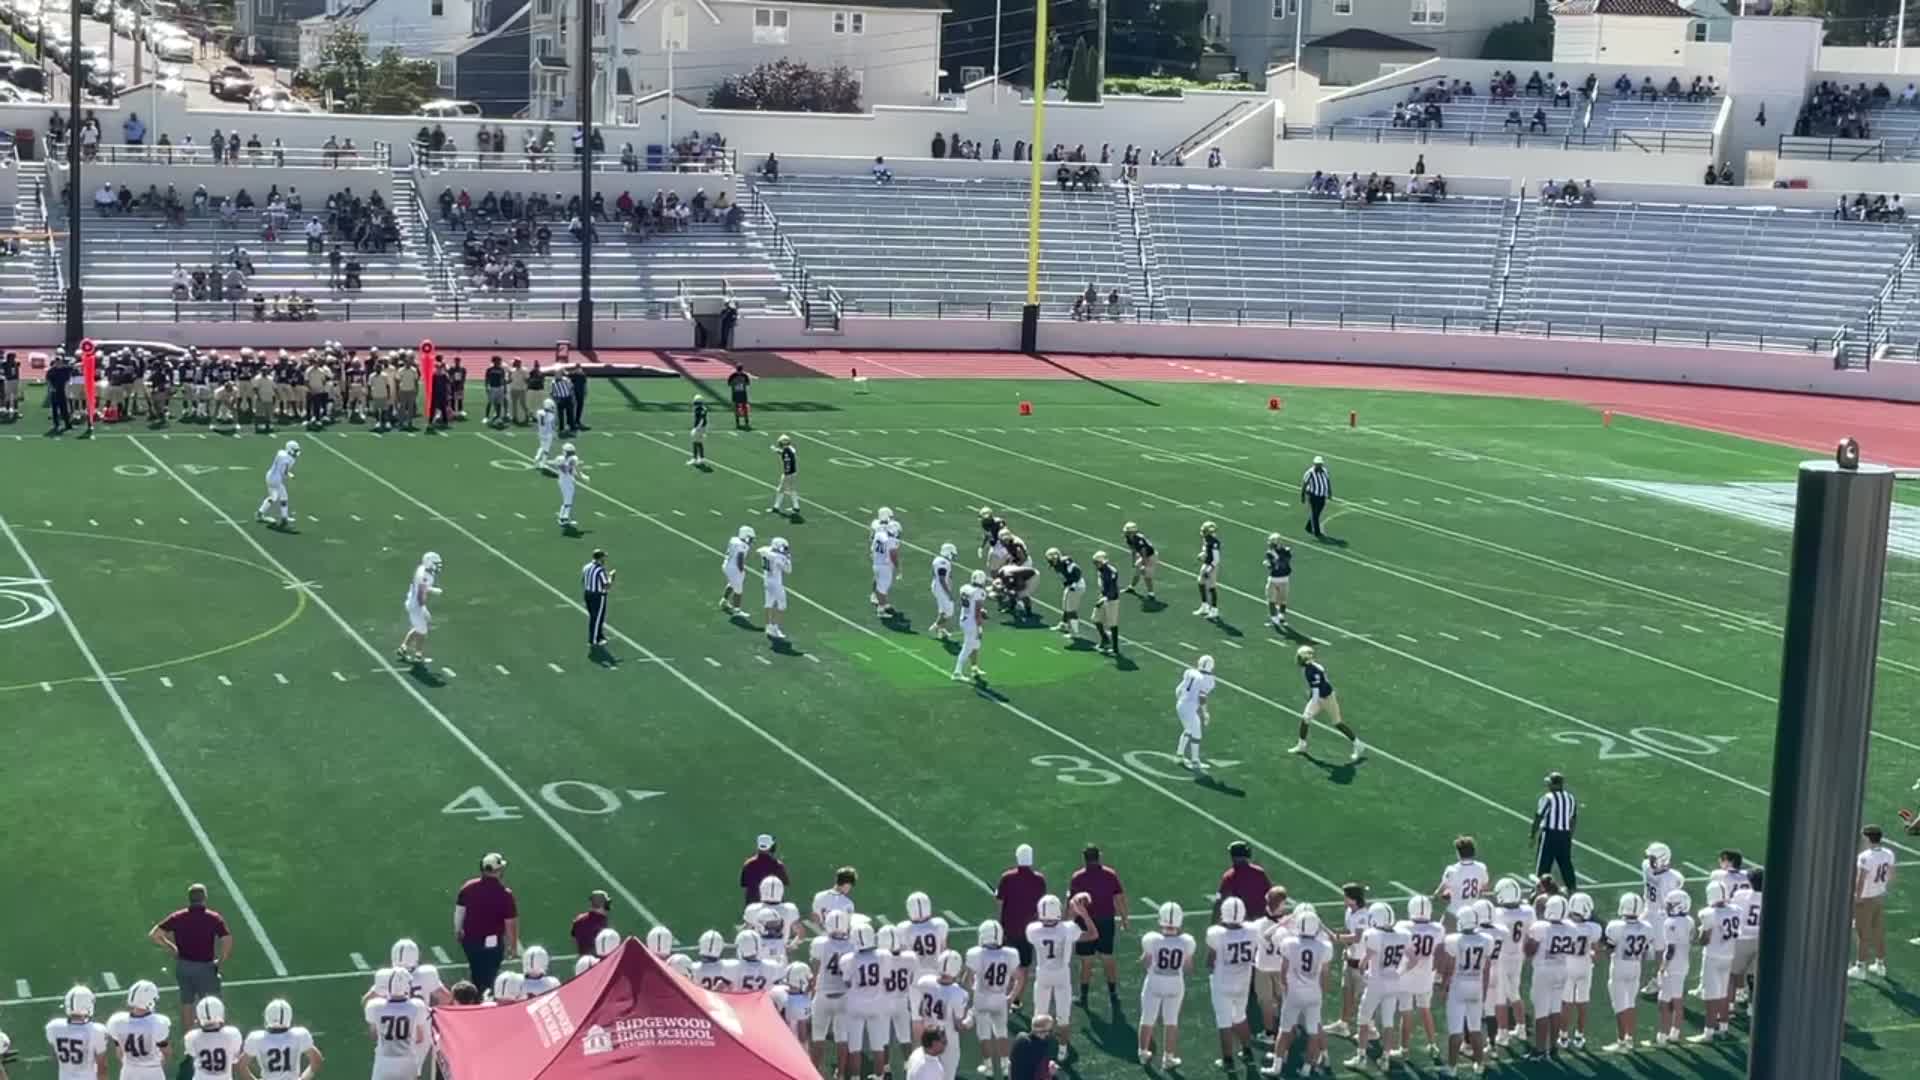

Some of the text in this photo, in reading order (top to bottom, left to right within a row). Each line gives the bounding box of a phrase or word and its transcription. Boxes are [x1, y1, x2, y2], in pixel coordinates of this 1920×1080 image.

[1549, 727, 1720, 760] 20
[441, 780, 622, 820] 40
[1462, 878, 1479, 899] 28
[914, 934, 937, 956] 49
[1042, 939, 1057, 959] 7
[1227, 941, 1252, 965] 75
[1384, 945, 1404, 968] 85
[1412, 934, 1434, 957] 30
[1157, 947, 1182, 971] 60
[1301, 949, 1313, 972] 9
[1463, 947, 1483, 970] 17
[858, 963, 880, 987] 19
[984, 963, 1007, 987] 48
[380, 1015, 410, 1041] 70
[615, 1016, 712, 1032] RIDGEWOOD
[656, 1028, 715, 1040] SCHOOL
[56, 1038, 84, 1065] 55
[124, 1033, 149, 1058] 41
[199, 1047, 227, 1073] 29
[266, 1047, 292, 1073] 21
